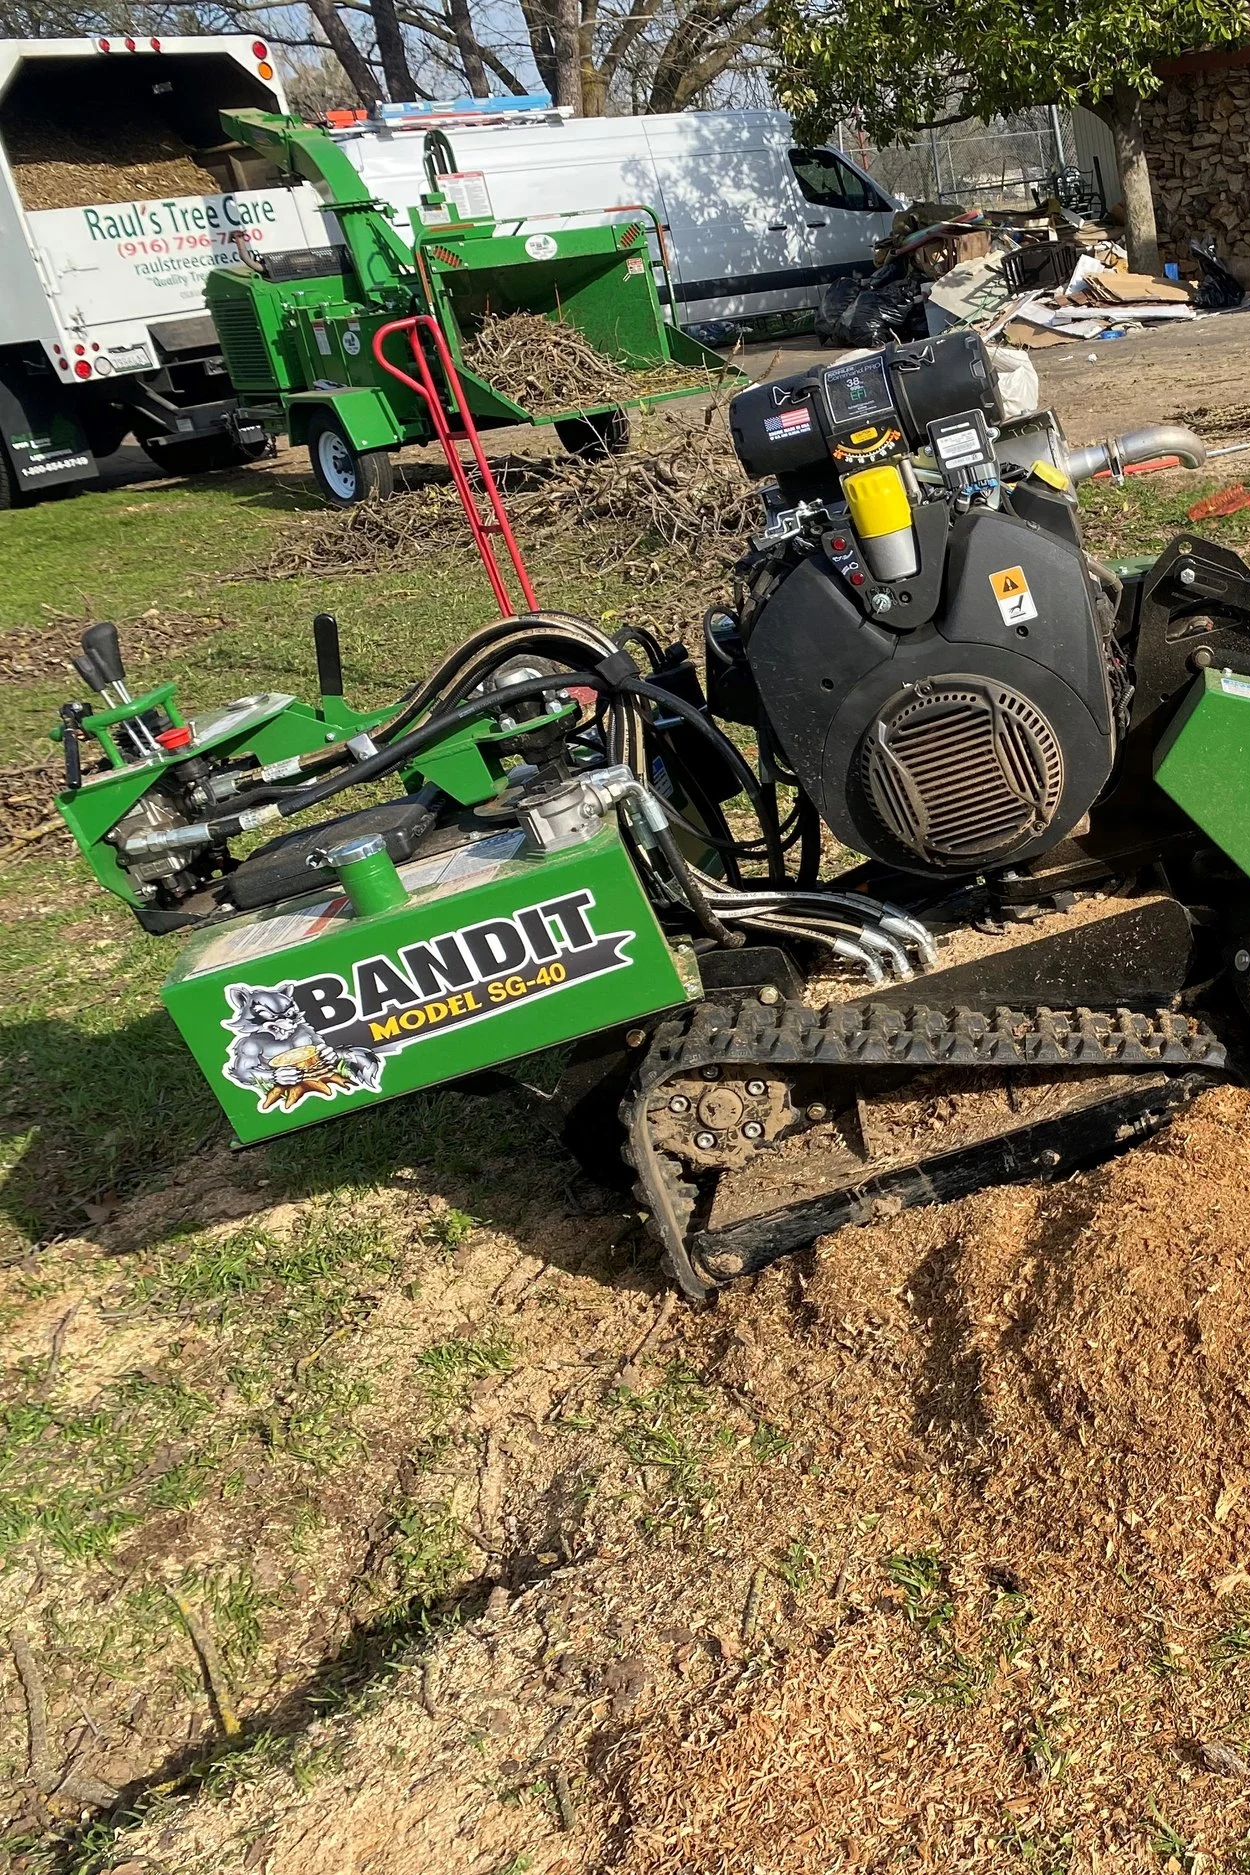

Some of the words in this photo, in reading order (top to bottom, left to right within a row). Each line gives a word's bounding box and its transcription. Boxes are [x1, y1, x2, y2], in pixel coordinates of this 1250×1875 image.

[83, 203, 162, 241] Raul's
[162, 202, 220, 233] Tree
[222, 195, 276, 227] Care
[117, 238, 170, 259] (916)
[133, 249, 261, 276] raulstreecare.cm
[864, 362, 881, 372] PRO
[846, 376, 860, 388] 38
[851, 387, 867, 401] EFI
[298, 892, 596, 1030] BANDIT
[369, 990, 483, 1042] MODEL
[488, 962, 567, 1001] SG-40
